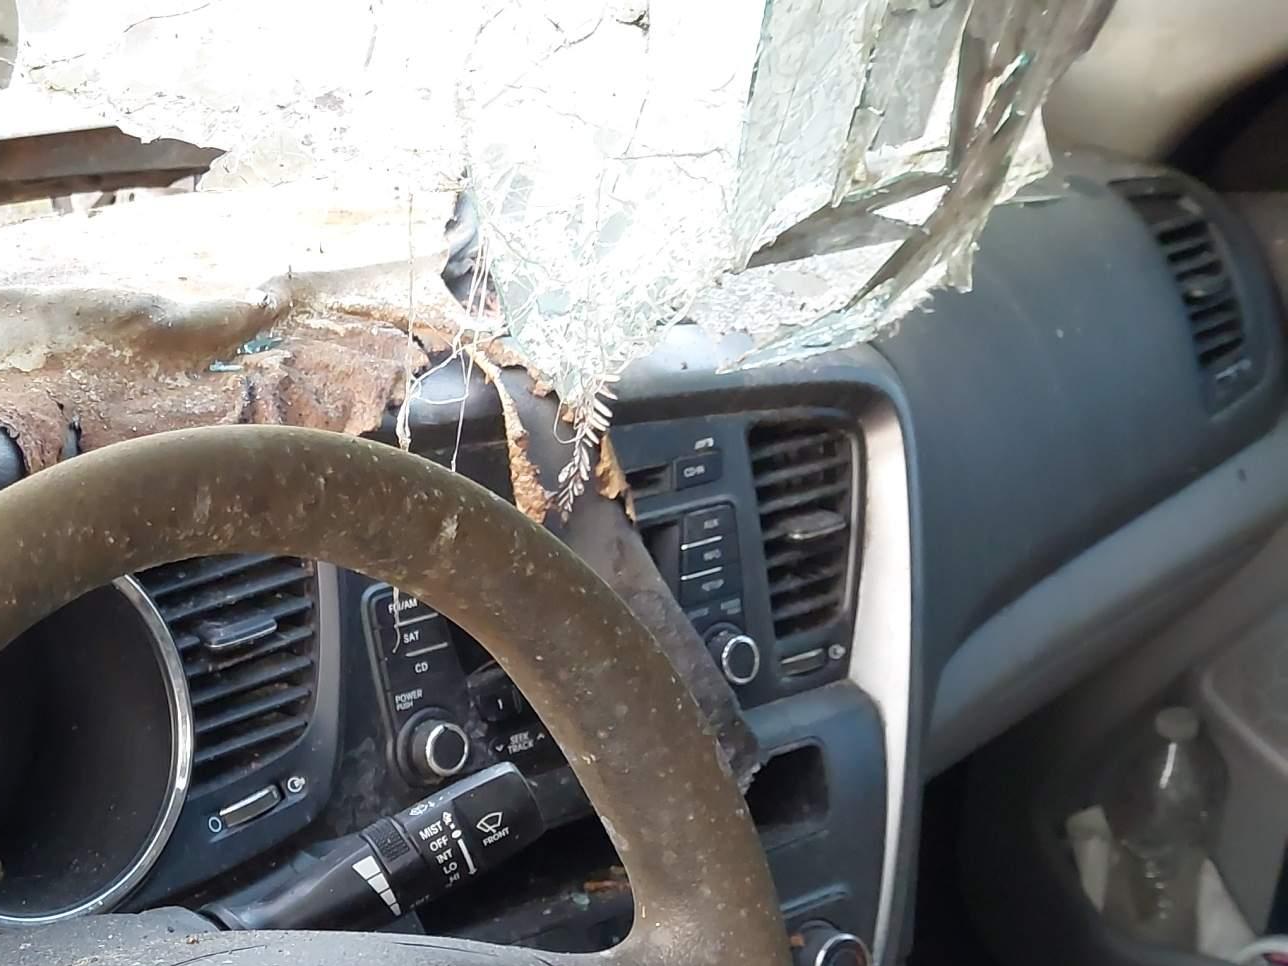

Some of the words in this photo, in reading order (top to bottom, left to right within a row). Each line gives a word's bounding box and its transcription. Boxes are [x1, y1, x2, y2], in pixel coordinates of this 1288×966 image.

[403, 631, 420, 644] SAT
[415, 661, 428, 673] CD
[395, 689, 423, 703] POWER
[396, 700, 413, 711] PUSH
[509, 731, 529, 744] SEEK
[508, 740, 534, 755] TRACK
[419, 820, 443, 840] MIST
[482, 826, 510, 846] FRONT
[429, 835, 449, 852] OFF
[436, 848, 453, 864] INT
[443, 862, 458, 875] LO
